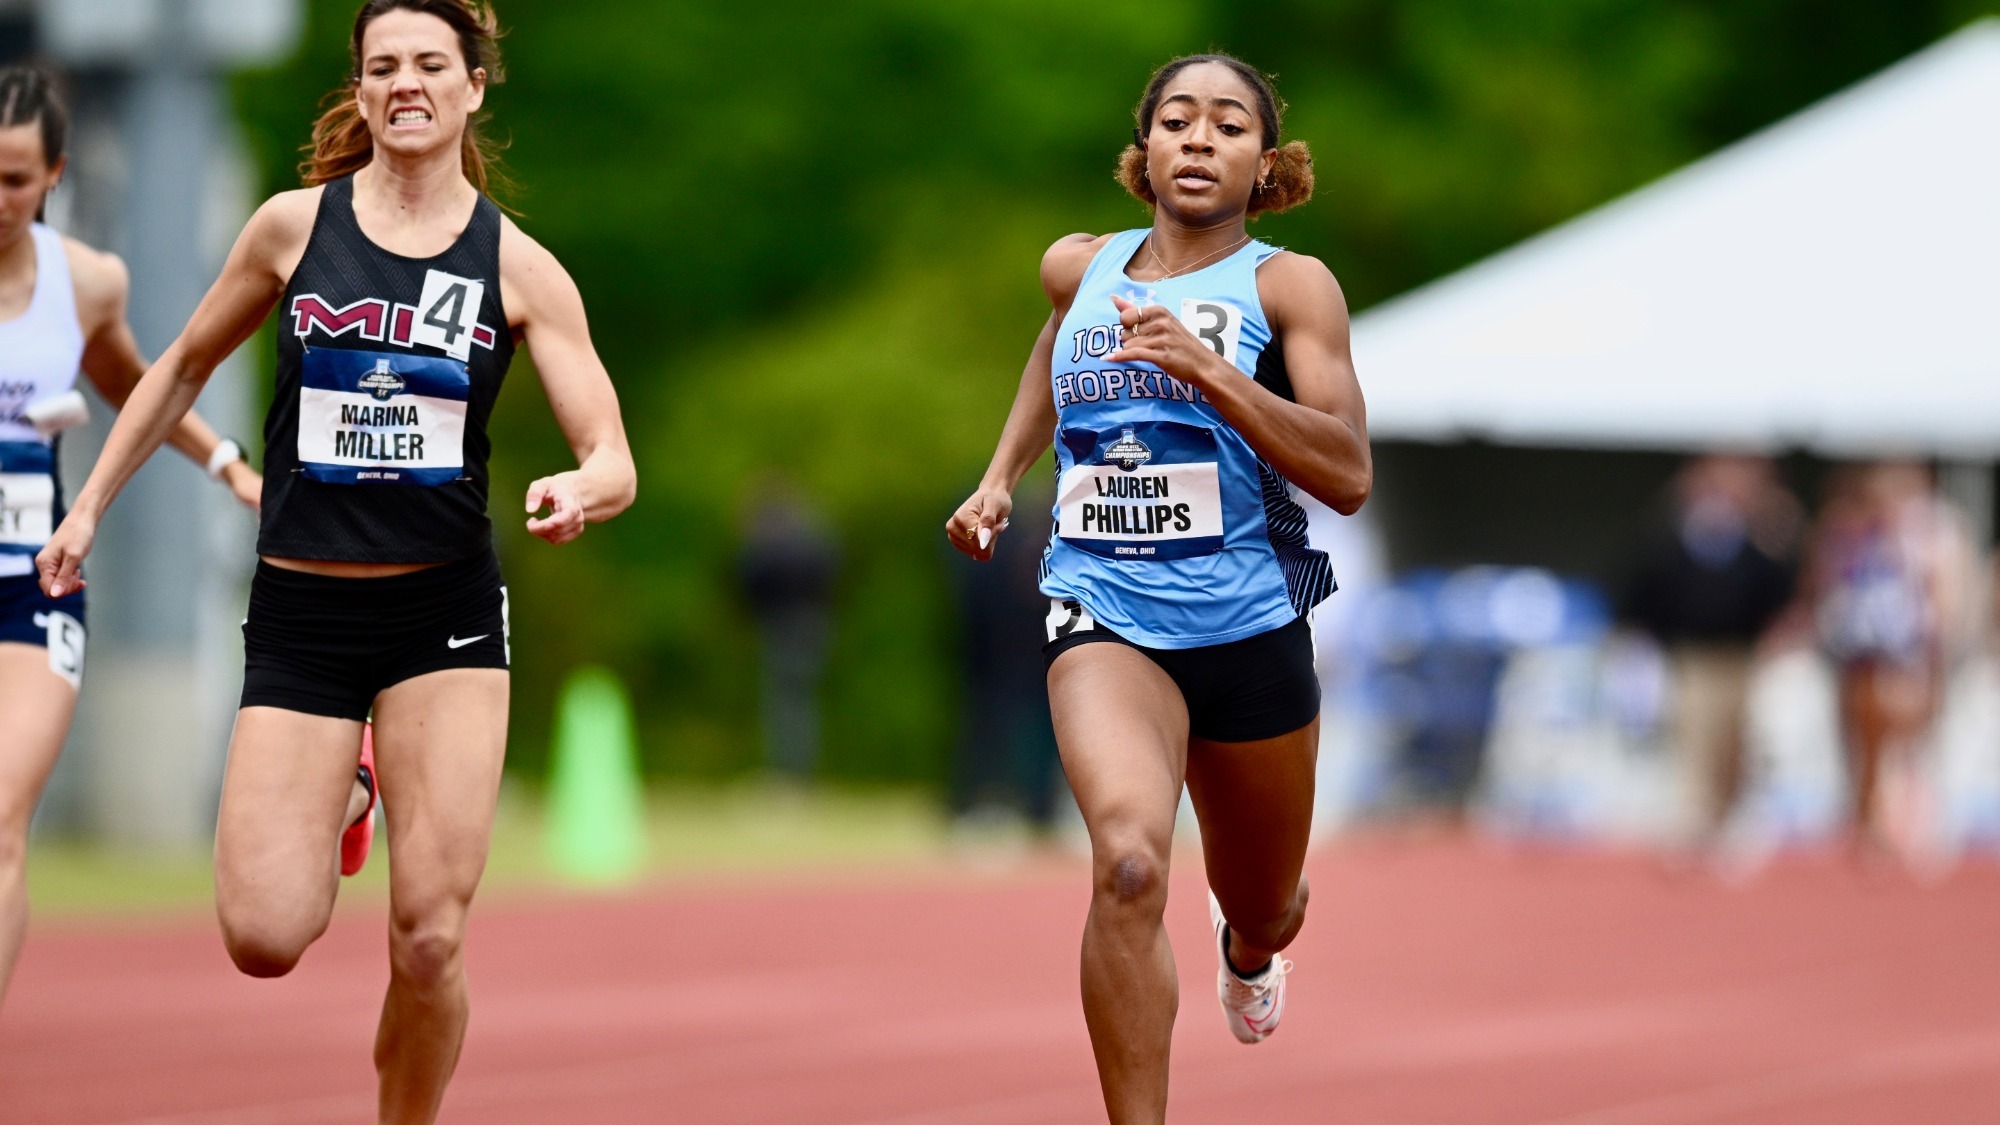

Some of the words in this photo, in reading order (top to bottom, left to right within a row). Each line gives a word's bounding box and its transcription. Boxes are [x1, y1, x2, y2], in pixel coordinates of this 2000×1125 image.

[291, 293, 496, 351] MI
[423, 282, 467, 345] 4
[1196, 304, 1228, 359] 3
[1056, 369, 1211, 409] HOPKIN
[341, 404, 419, 427] MARINA
[335, 430, 424, 460] MILLER
[1105, 451, 1150, 459] CHAMPIONSHIPS
[383, 472, 400, 480] OHIO
[1094, 476, 1169, 498] LAUREN
[1082, 503, 1191, 534] PHILLIPS
[1115, 547, 1139, 555] GENEVA,
[1140, 547, 1156, 555] OHIO
[62, 622, 77, 673] 5
